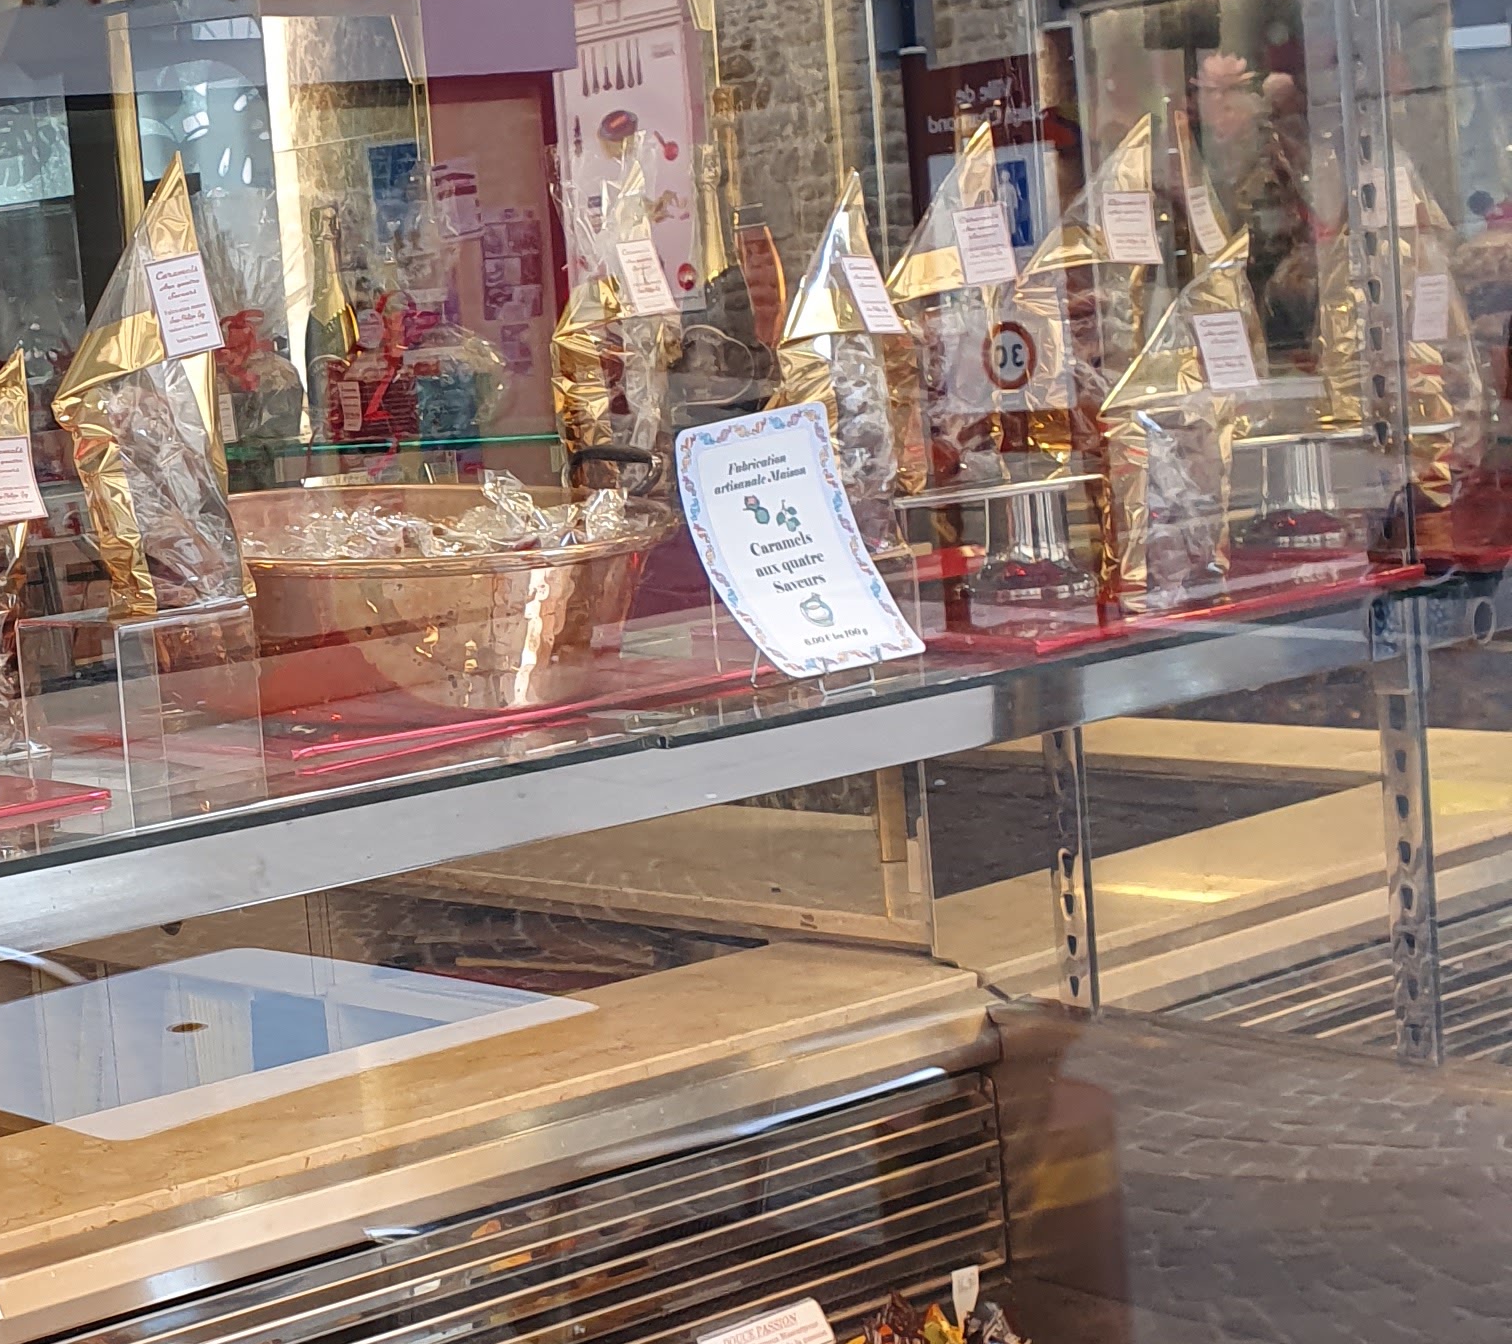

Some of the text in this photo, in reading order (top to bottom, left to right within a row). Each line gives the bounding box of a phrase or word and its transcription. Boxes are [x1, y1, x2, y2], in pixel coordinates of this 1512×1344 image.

[728, 452, 788, 476] Fabrication
[713, 475, 768, 496] artisanale
[750, 530, 814, 557] Caramels
[755, 551, 826, 578] aux quatre
[773, 573, 827, 595] Saveurs
[756, 1312, 799, 1339] PASSION
